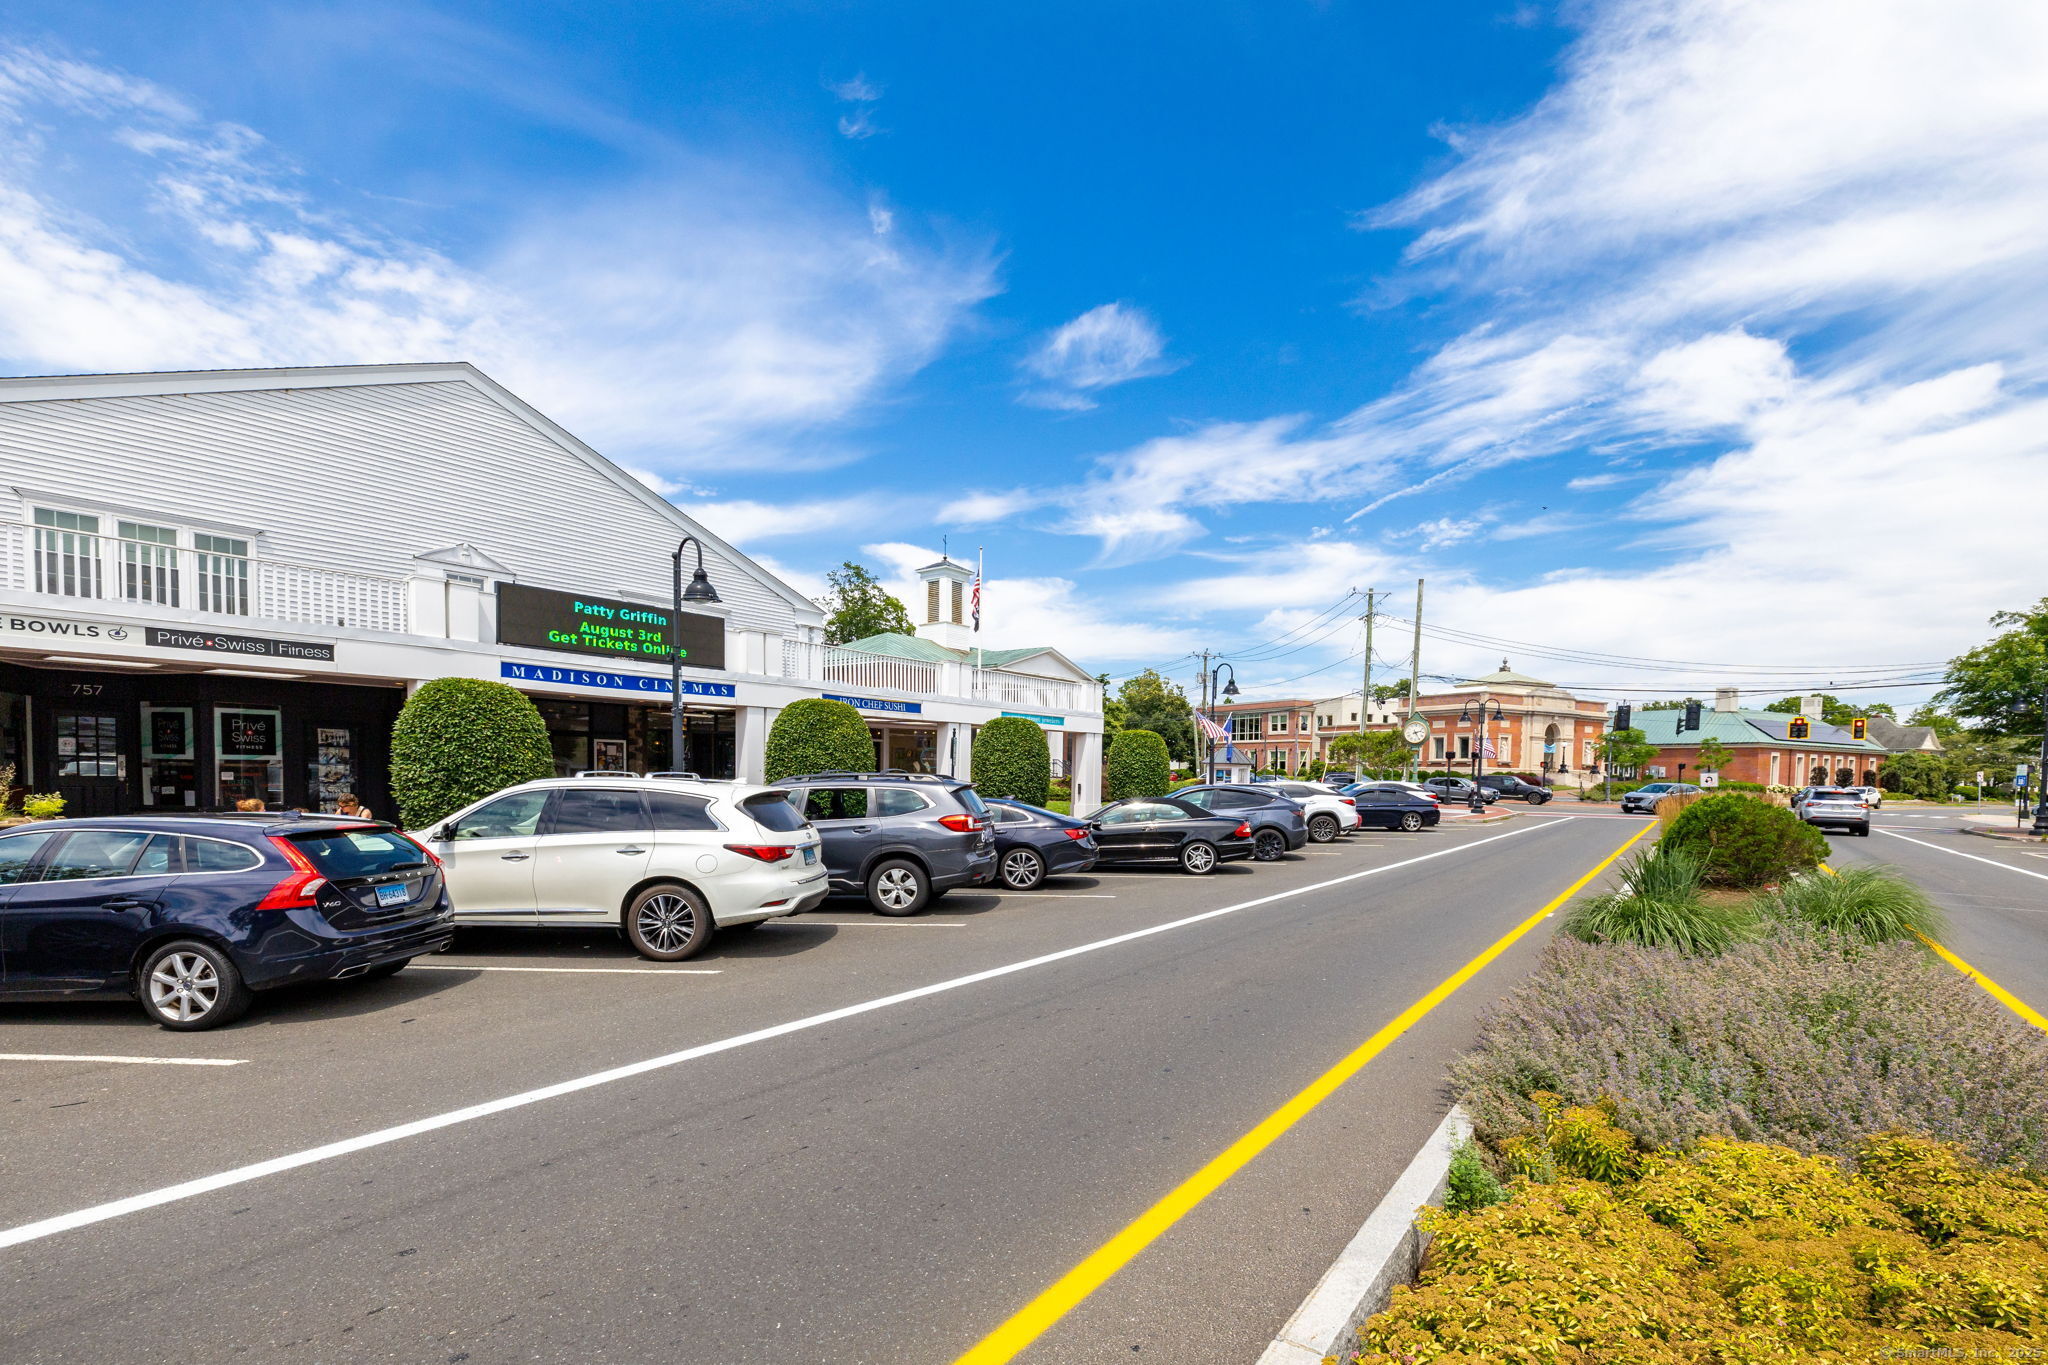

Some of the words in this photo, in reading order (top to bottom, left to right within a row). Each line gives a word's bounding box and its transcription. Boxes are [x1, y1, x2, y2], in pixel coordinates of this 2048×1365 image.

[574, 601, 614, 619] Patty
[620, 609, 667, 625] Griffin
[10, 618, 100, 637] BOWLS
[580, 621, 633, 638] August
[638, 630, 662, 642] 3rd
[157, 631, 203, 647] Privé
[215, 637, 265, 653] Swiss
[279, 643, 330, 658] Fitness
[548, 630, 578, 644] Get
[582, 634, 638, 652] Tickets
[643, 643, 687, 658] Onlie
[511, 665, 623, 687] MADISON
[71, 684, 103, 695] 757
[862, 700, 883, 710] CHEF
[884, 702, 906, 712] SUSHI
[232, 719, 266, 731] Privé
[232, 731, 266, 743] Swiss
